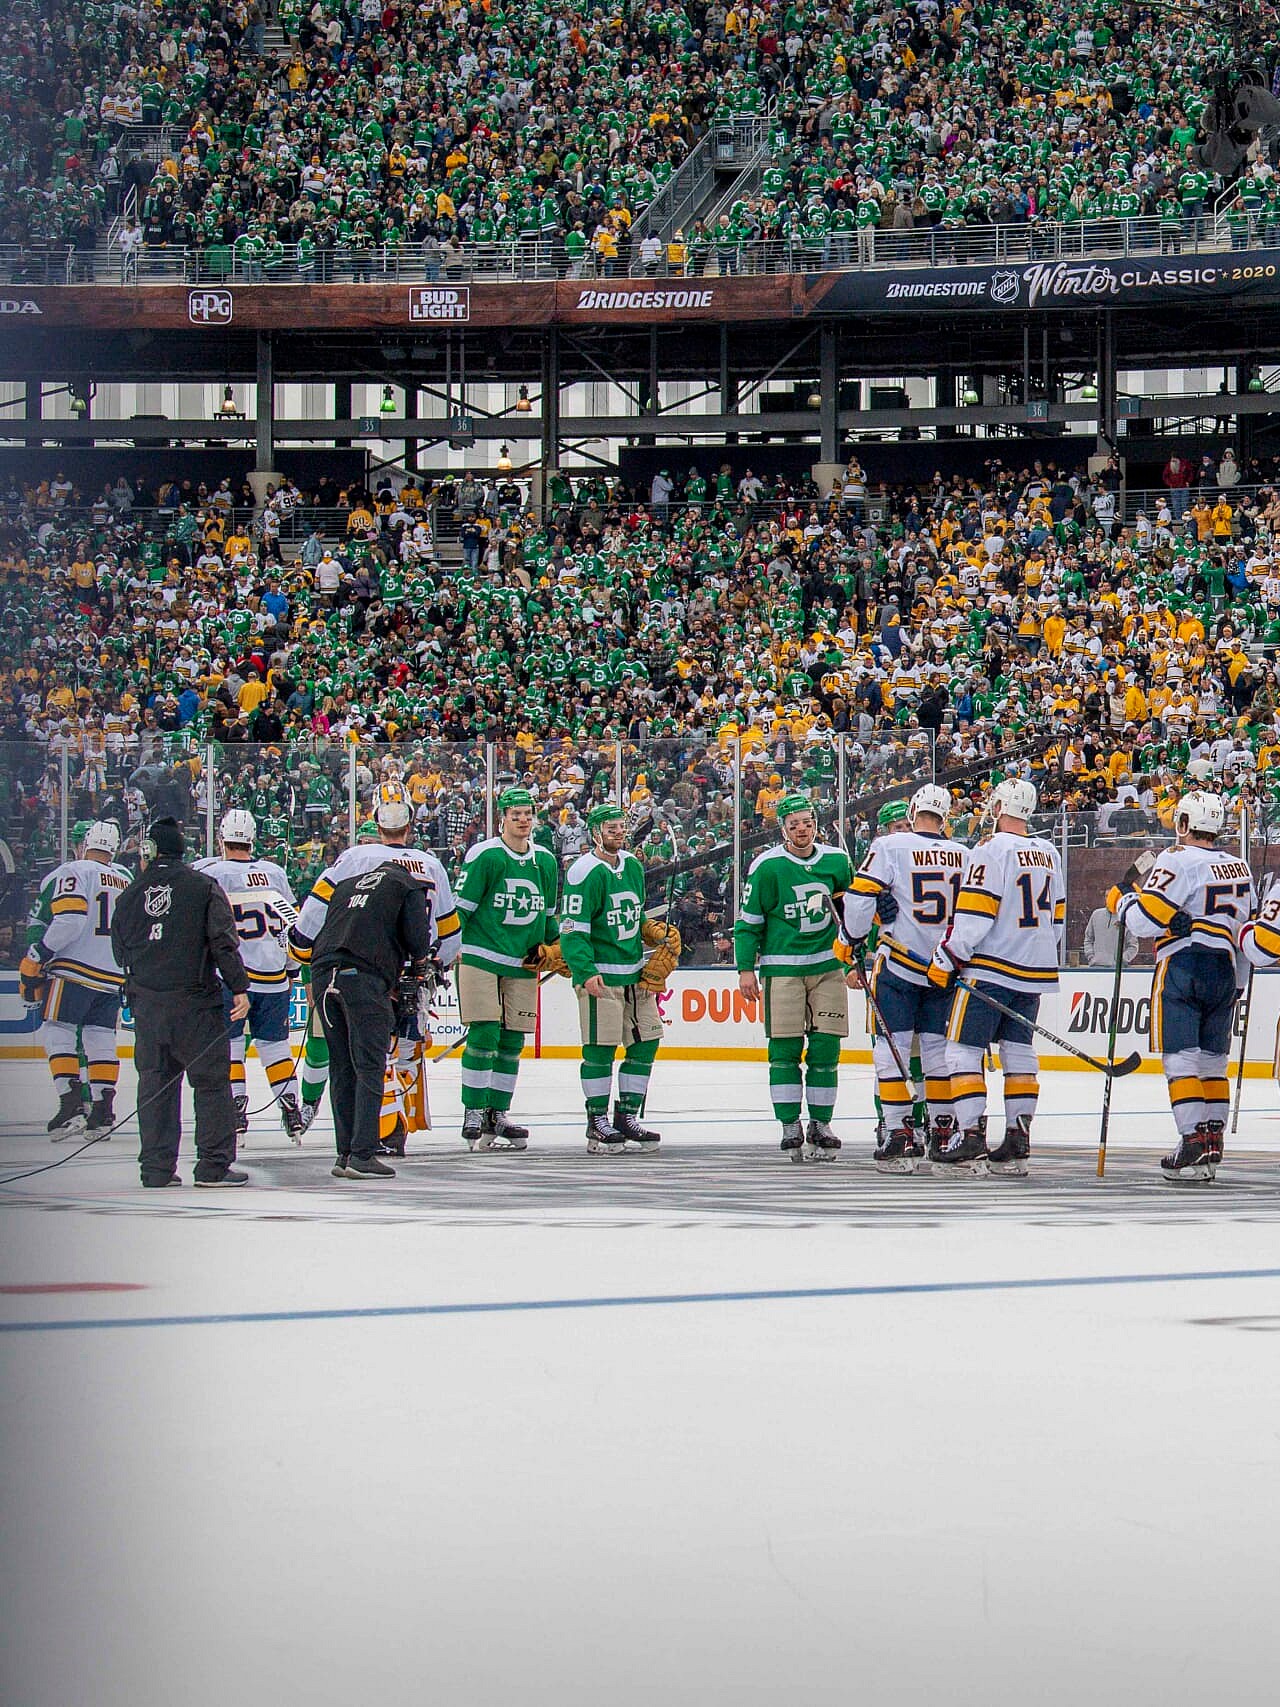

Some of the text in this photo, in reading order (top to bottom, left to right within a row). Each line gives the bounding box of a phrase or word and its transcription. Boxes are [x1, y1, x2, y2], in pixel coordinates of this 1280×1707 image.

[886, 281, 987, 298] BRIDGESTONE
[1023, 262, 1121, 308] Winter
[1232, 265, 1276, 280] 2020
[191, 294, 230, 320] PPG
[420, 292, 458, 305] BUD
[576, 291, 713, 309] BRIDGESTONE
[413, 305, 466, 319] LIGHT
[912, 850, 962, 868] WATSON
[246, 873, 269, 887] JOSI
[966, 863, 986, 886] 14
[1147, 868, 1176, 892] 57
[1210, 862, 1250, 880] FABBRO
[59, 876, 76, 894] 13
[347, 894, 370, 908] 104
[562, 894, 584, 915] 18
[911, 871, 961, 926] 51
[1016, 873, 1051, 928] 14
[94, 891, 112, 936] 1
[682, 989, 765, 1023] DUN
